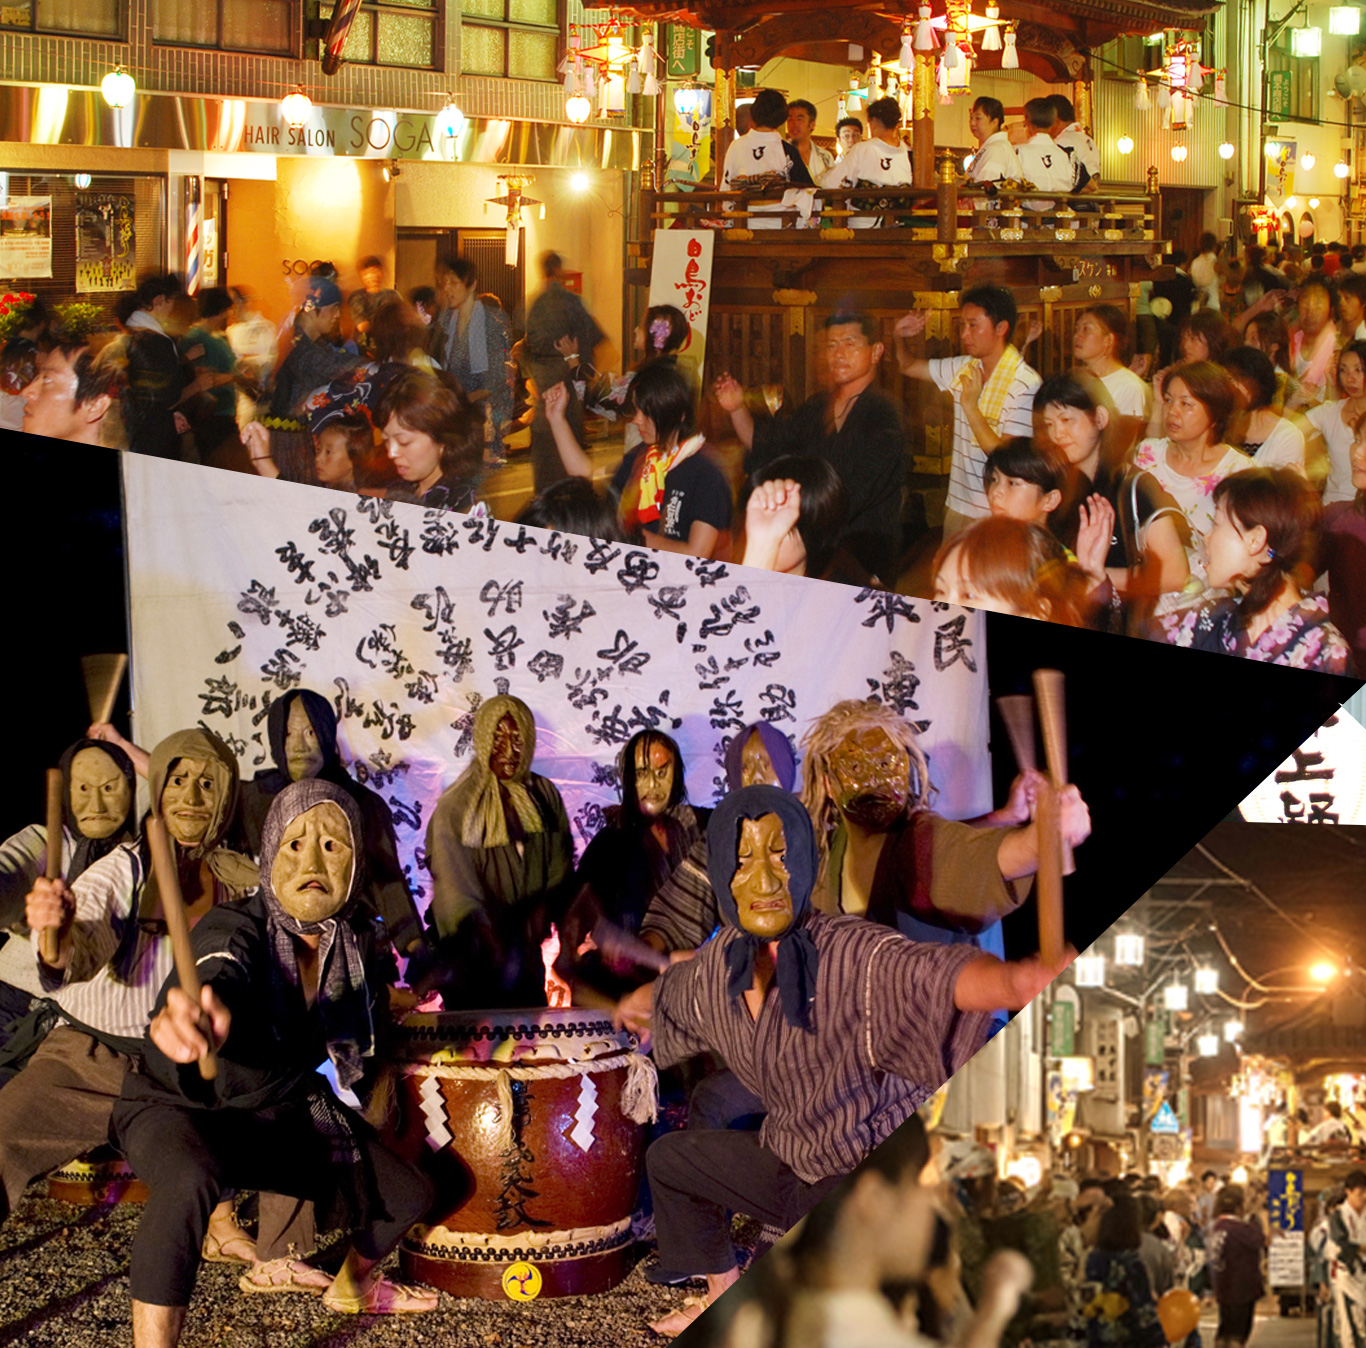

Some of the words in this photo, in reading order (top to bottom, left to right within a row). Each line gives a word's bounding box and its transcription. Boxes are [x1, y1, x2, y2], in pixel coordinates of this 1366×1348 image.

[244, 125, 280, 145] HAIR
[288, 127, 335, 148] SALON
[350, 116, 435, 152] SOGA
